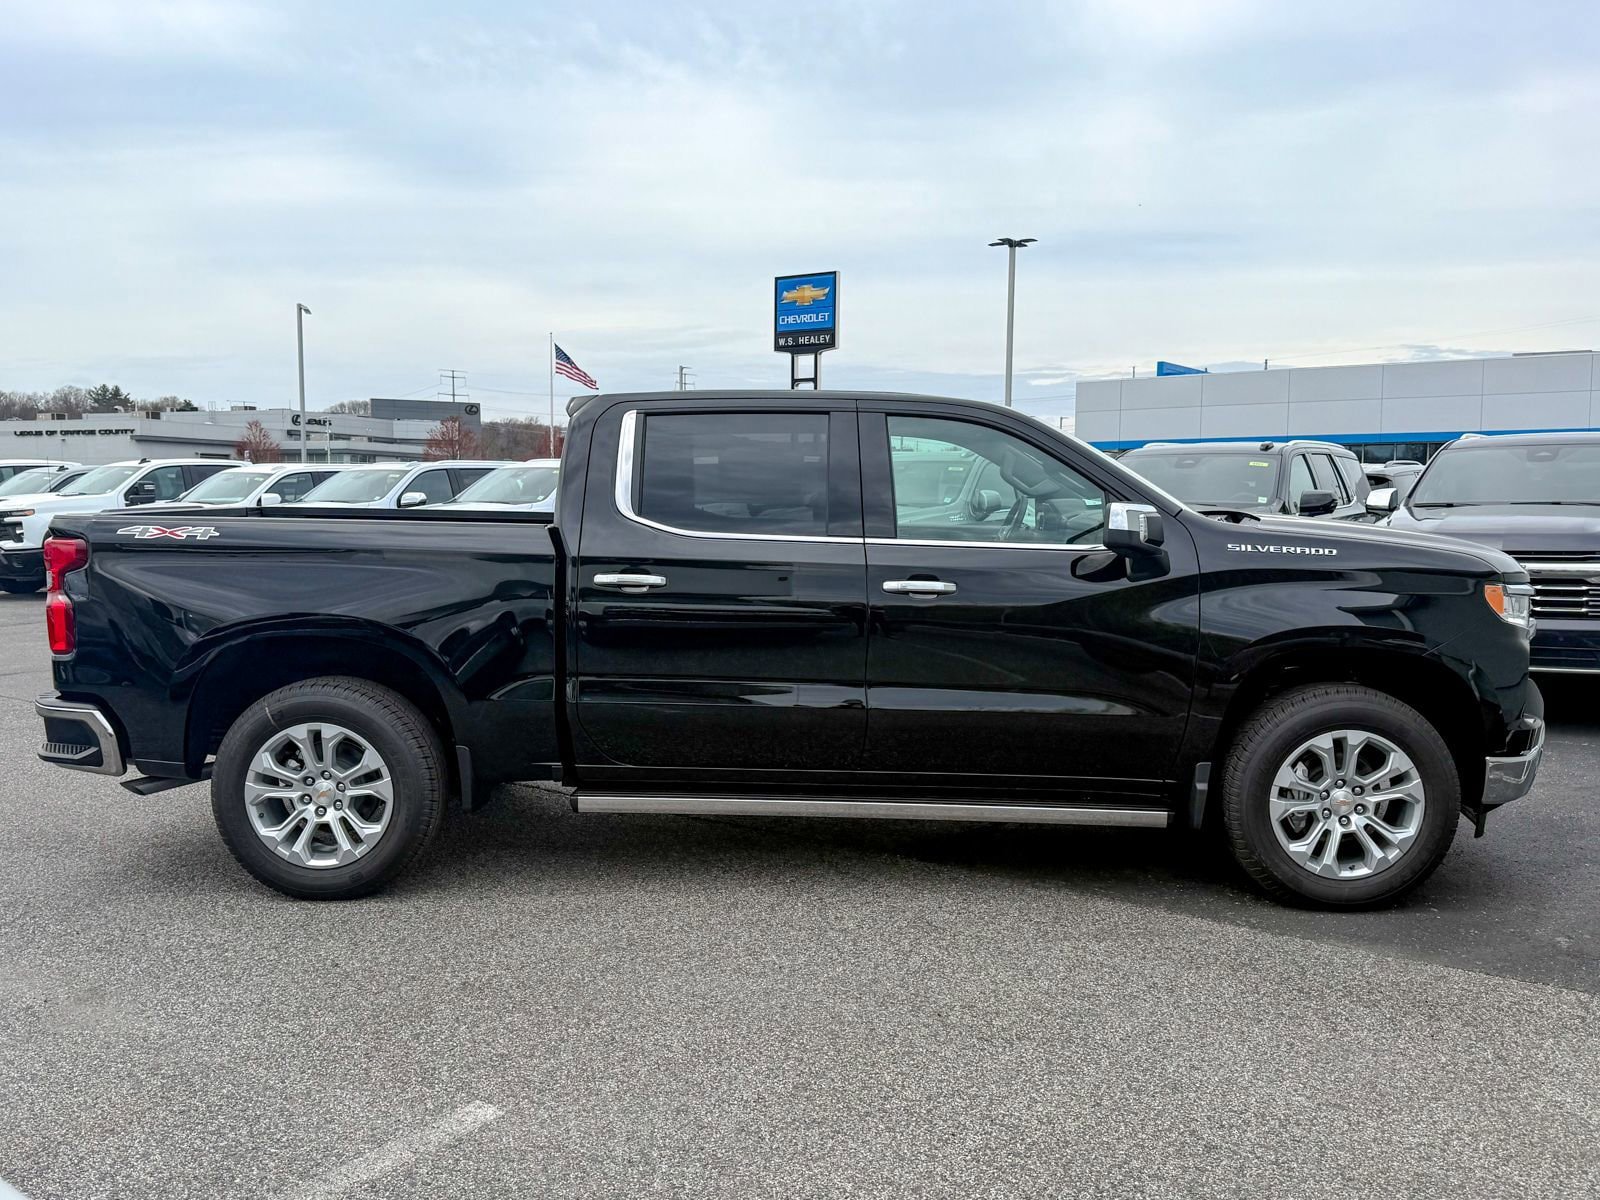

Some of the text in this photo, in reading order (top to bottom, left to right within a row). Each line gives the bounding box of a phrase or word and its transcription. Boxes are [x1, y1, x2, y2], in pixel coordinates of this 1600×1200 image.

[779, 312, 830, 325] CHEVROLET
[778, 334, 831, 346] W.S. HEALEY
[1227, 543, 1338, 556] SILVERADO
